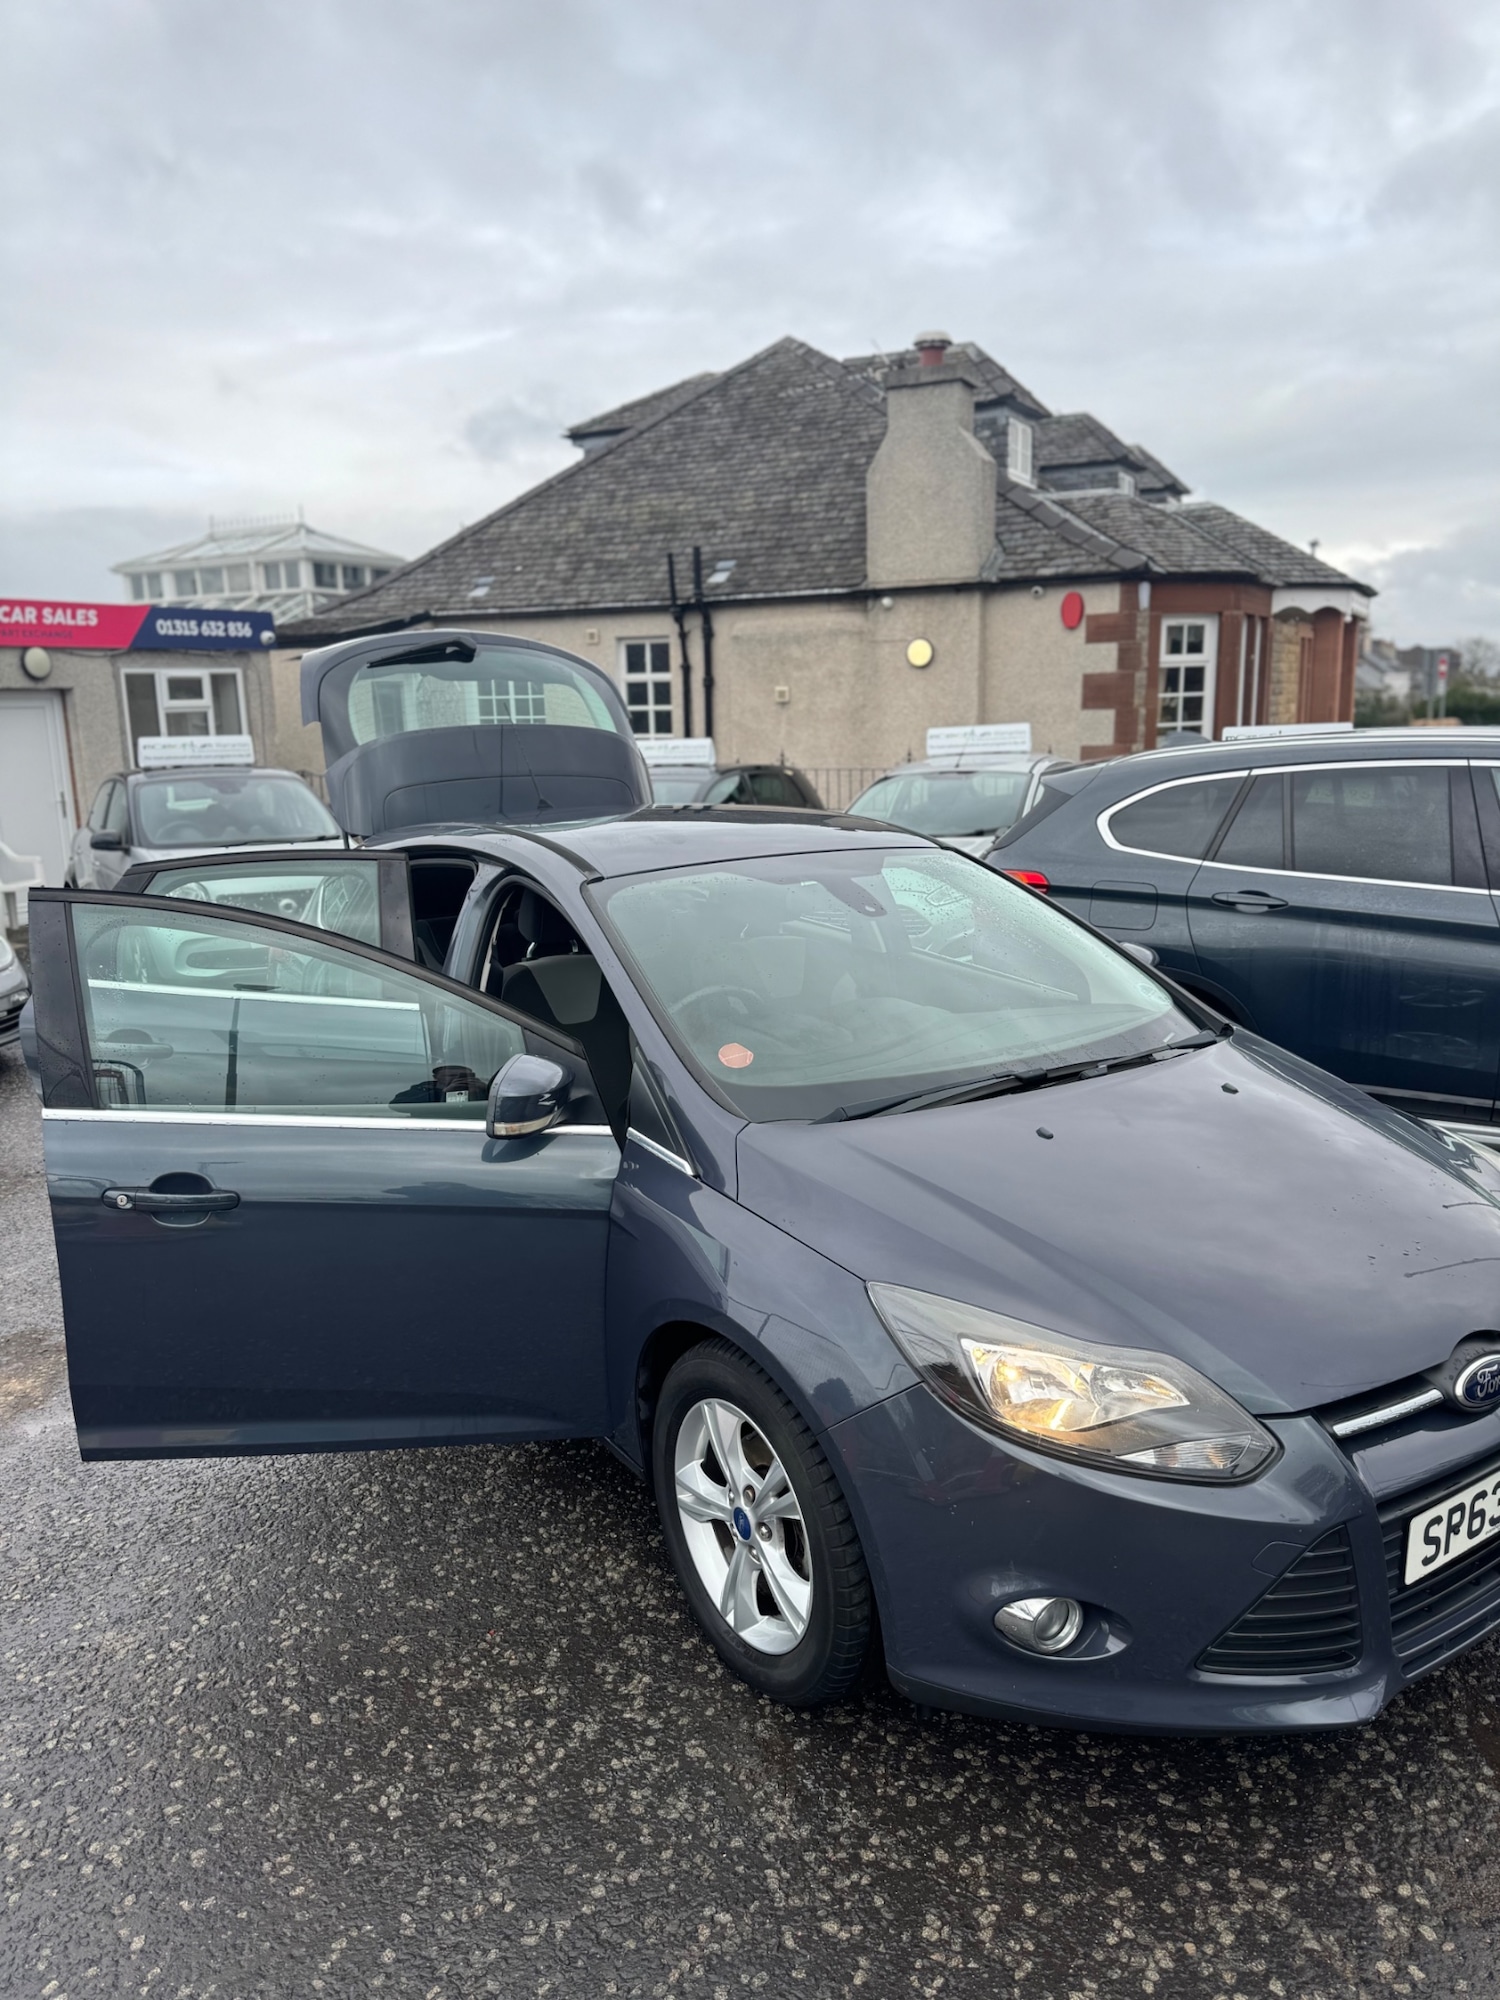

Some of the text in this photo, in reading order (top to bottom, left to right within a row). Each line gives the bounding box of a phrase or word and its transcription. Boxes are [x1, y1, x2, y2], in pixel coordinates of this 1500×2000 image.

[0, 605, 98, 627] CAR SALES
[0, 628, 20, 638] ART
[155, 618, 253, 639] 01315 632 836
